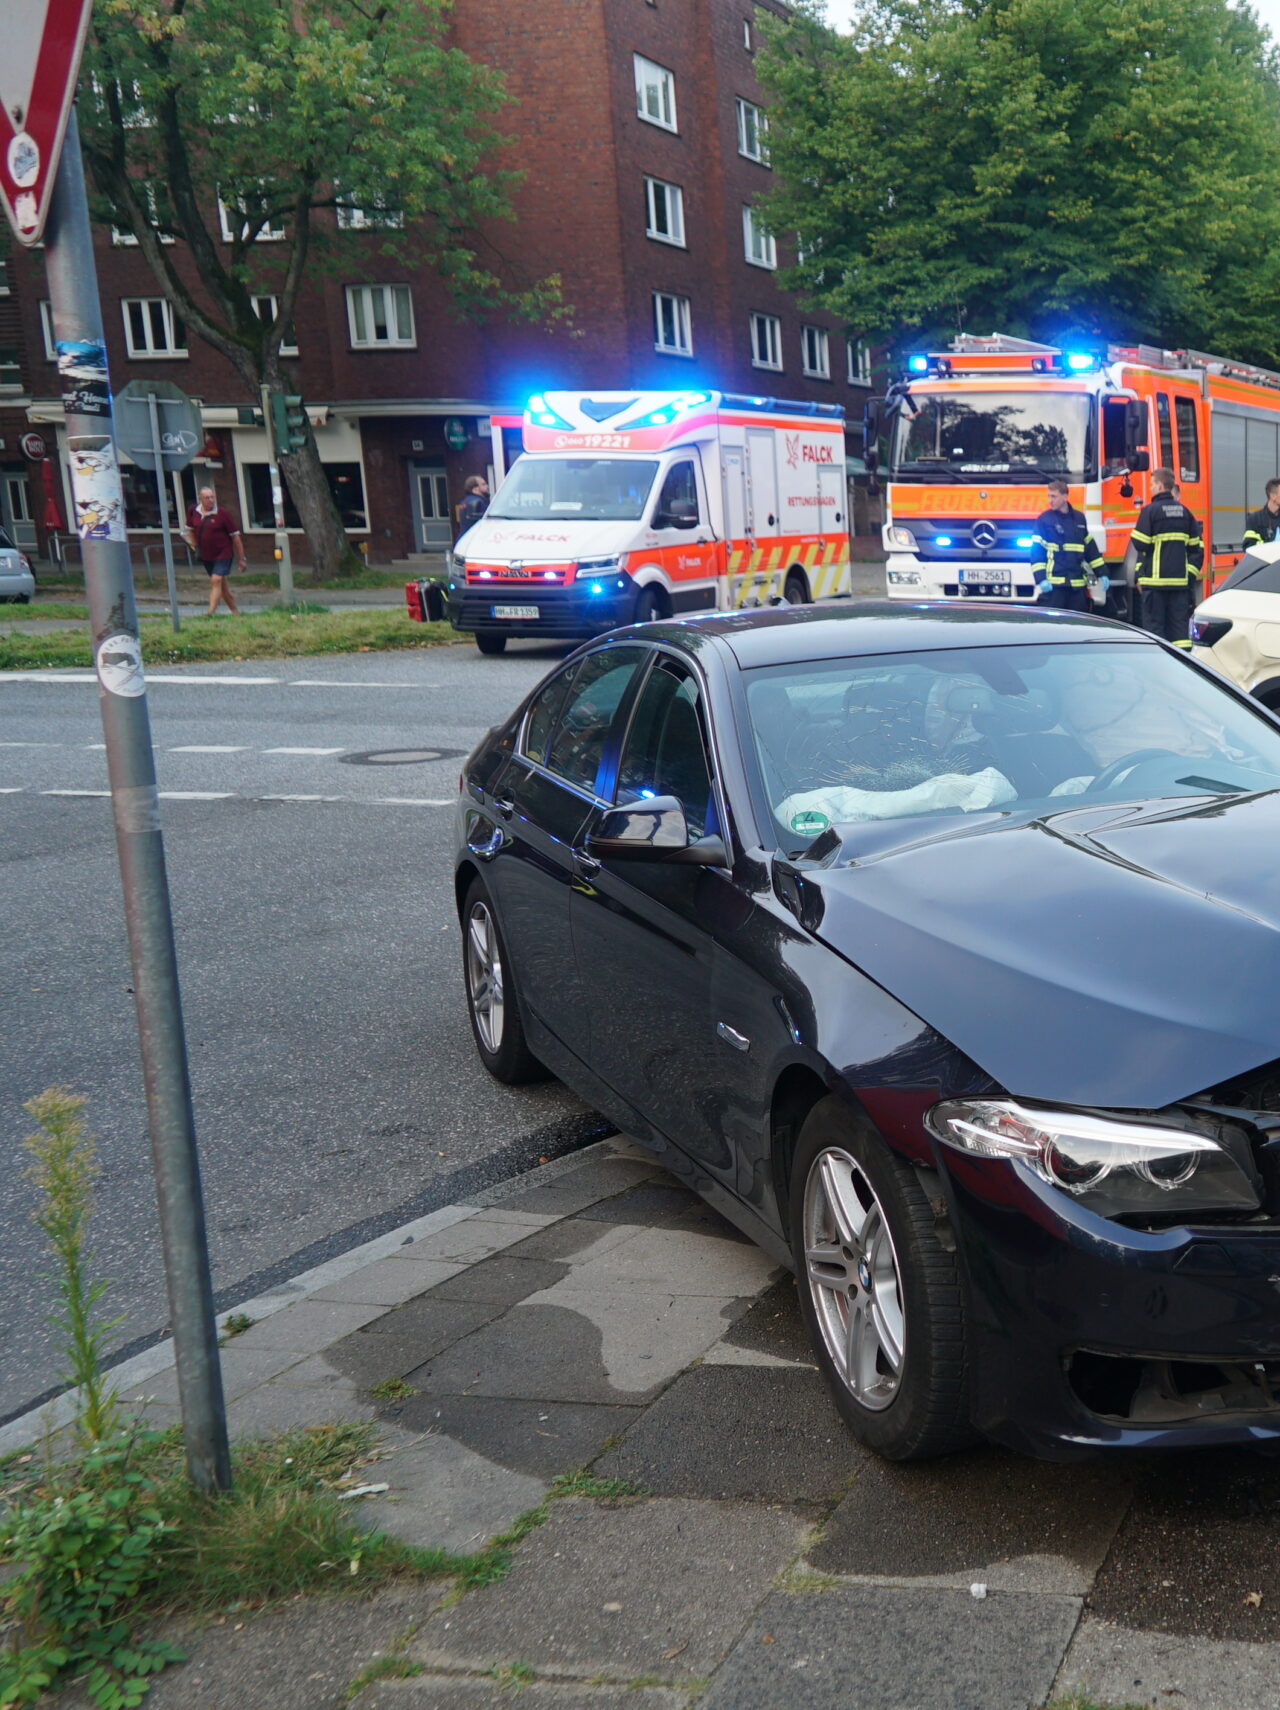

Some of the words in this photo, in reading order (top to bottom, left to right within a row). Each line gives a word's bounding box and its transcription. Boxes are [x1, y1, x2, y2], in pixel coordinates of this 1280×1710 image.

[584, 434, 631, 448] 19221
[802, 445, 833, 463] FALCK
[787, 496, 836, 507] RETTUNGSWAGEN
[515, 534, 571, 542] FALCK
[984, 572, 1005, 581] 2561
[804, 811, 816, 822] 4
